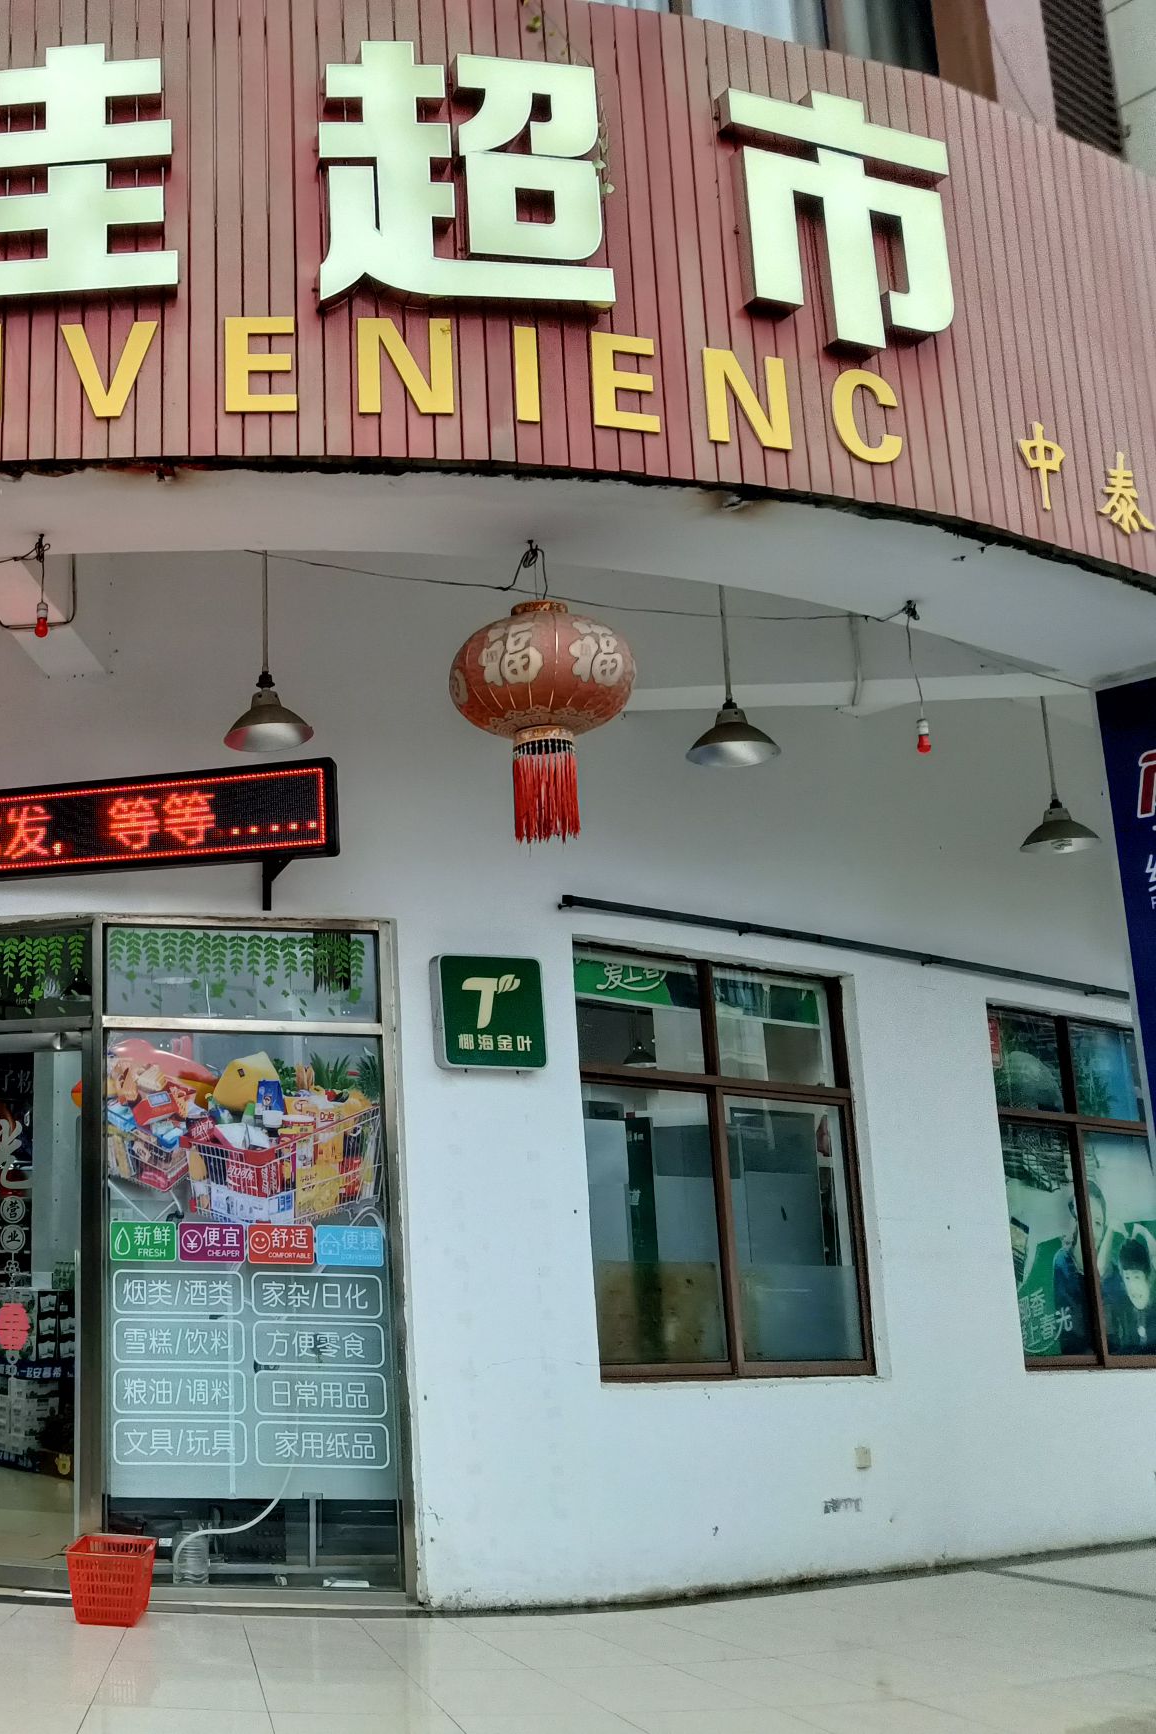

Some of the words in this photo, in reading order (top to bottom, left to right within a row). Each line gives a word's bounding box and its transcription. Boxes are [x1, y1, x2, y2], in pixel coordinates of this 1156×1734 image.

[1018, 422, 1154, 534] 中泰
[134, 1226, 171, 1247] 新鲜
[203, 1226, 241, 1248] 便宜
[271, 1228, 309, 1249] 舒适
[137, 1248, 166, 1257] FRESH
[207, 1249, 240, 1257] CHEAPER
[268, 1251, 311, 1259] COMFORTABLE
[122, 1279, 233, 1306] 烟类/酒类
[262, 1281, 368, 1309] 家杂/日化
[123, 1328, 233, 1355] 雪糕/饮料
[266, 1331, 365, 1359] 方便零食
[123, 1378, 234, 1406] 粮油/调料
[272, 1381, 369, 1408] 日常用品
[123, 1428, 235, 1456] 文具/玩具
[275, 1431, 377, 1459] 家用纸品
